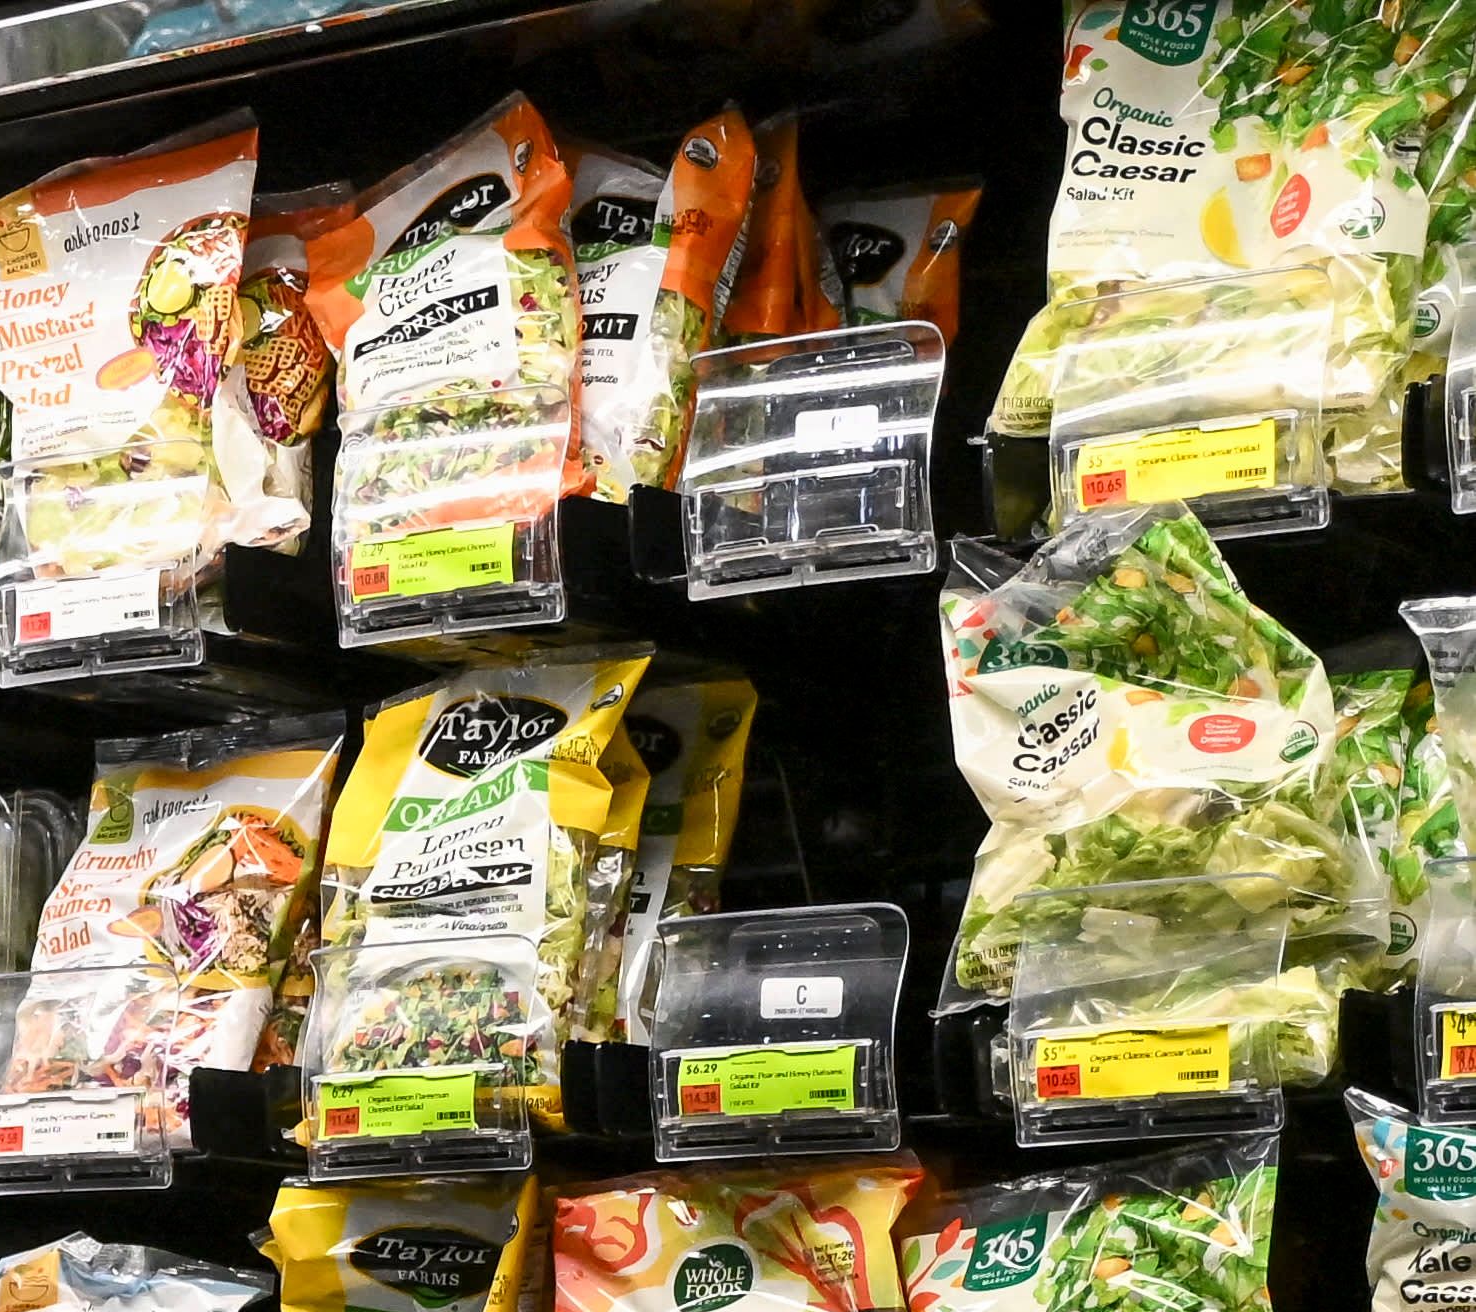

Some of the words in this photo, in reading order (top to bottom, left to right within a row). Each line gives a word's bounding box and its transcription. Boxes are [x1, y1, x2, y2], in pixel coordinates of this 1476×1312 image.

[1132, 0, 1203, 38] 365
[1128, 29, 1160, 44] WHOLE
[1093, 86, 1174, 129] Organic
[1082, 116, 1206, 158] Classic
[1071, 150, 1197, 184] Caesar
[378, 249, 457, 296] Honey
[453, 292, 491, 314] KIT
[593, 318, 629, 334] KIT
[1, 343, 84, 384] Pretzel
[438, 712, 556, 744] Taylor
[458, 745, 522, 768] FARMS
[1013, 716, 1101, 775] Caesar
[421, 815, 504, 857] Lemon
[74, 845, 158, 874] Crunchy
[389, 837, 526, 881] Parmesan
[485, 865, 530, 882] KIT
[36, 925, 92, 958] Salad
[685, 1063, 718, 1077] $6.29
[375, 1235, 490, 1268] Taylor
[975, 1224, 1035, 1273] 365
[1406, 1245, 1471, 1274] Kale
[398, 1268, 460, 1287] FARMS
[684, 1265, 745, 1285] WHOLE
[684, 1281, 745, 1300] FOODS
